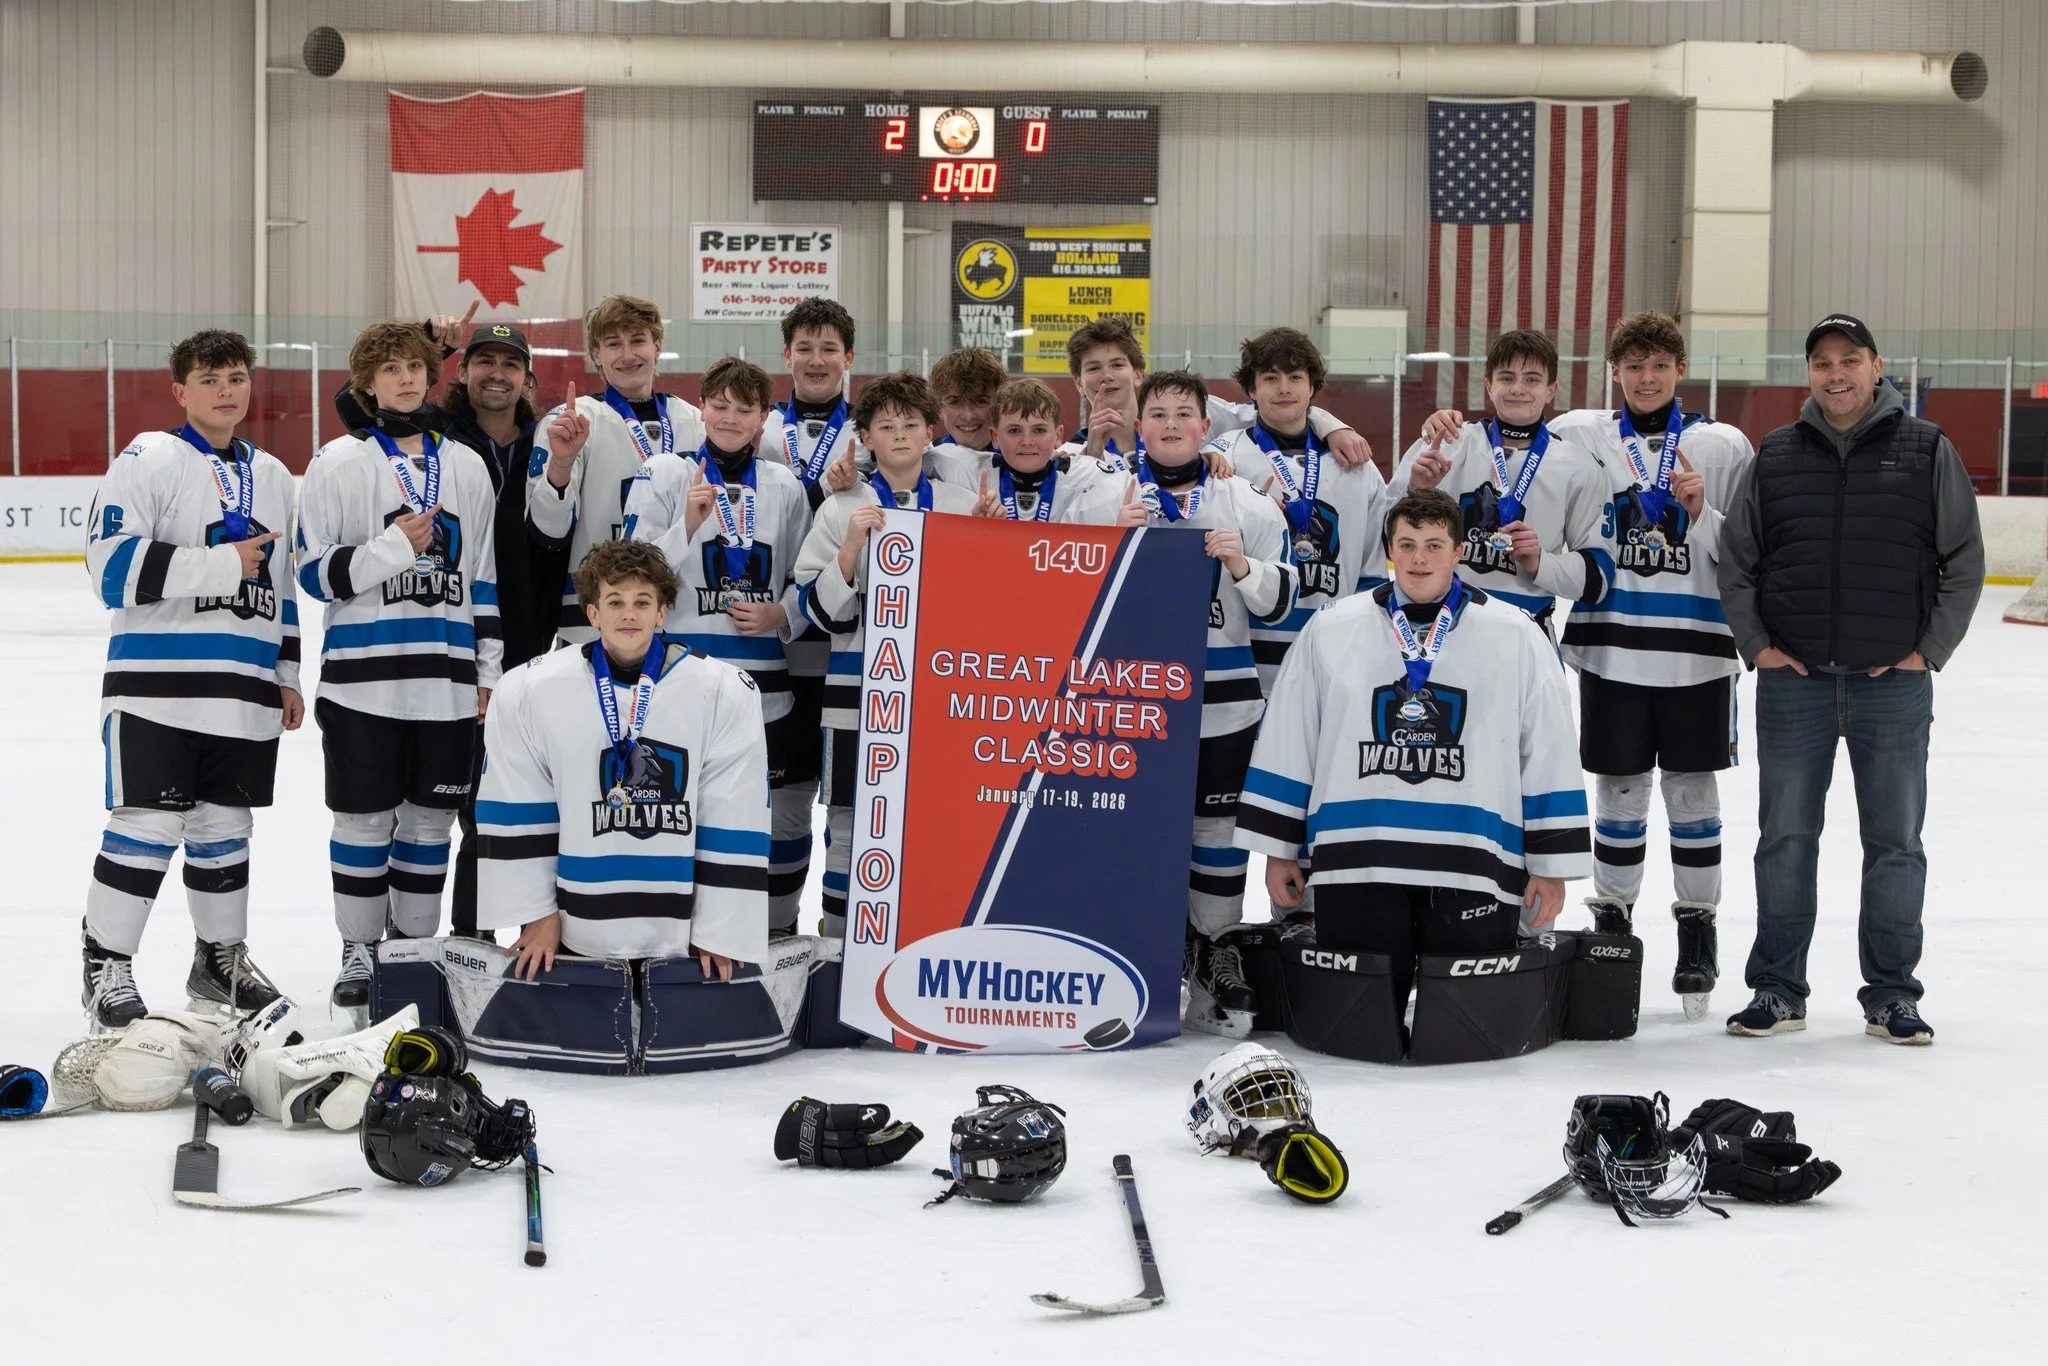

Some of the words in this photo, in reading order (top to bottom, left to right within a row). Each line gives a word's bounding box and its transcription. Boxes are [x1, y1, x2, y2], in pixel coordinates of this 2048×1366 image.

[758, 106, 794, 115] PLAYER
[804, 106, 846, 116] PENALTY
[864, 104, 909, 118] HOME
[1003, 106, 1052, 120] GUEST
[1062, 108, 1097, 118] PLAYER
[1107, 110, 1148, 120] PENALTY
[885, 120, 906, 151] 2
[1025, 121, 1046, 152] 0
[933, 162, 997, 193] 0:00
[700, 230, 832, 252] REPETE'S
[1059, 242, 1090, 252] WEST
[1092, 242, 1126, 252] SHORE
[702, 256, 762, 274] PARTY
[768, 256, 828, 274] STORE
[1056, 252, 1120, 264] HOLLAND
[760, 282, 789, 290] Liquor
[797, 282, 830, 291] Lottery
[1068, 286, 1112, 297] LUNCH
[722, 294, 802, 304] 616-399-005
[959, 304, 1014, 316] BUFFALO
[1068, 298, 1112, 306] MADNESS
[722, 308, 752, 316] Corner
[1030, 314, 1087, 324] BONELESS
[958, 316, 1014, 334] WILD
[958, 332, 1014, 348] WINGS
[632, 424, 654, 458] MYHOCK
[661, 416, 672, 454] MPION
[1502, 428, 1530, 439] CCM
[807, 426, 838, 480] CHAMPION
[1658, 432, 1678, 490] CHAMPION
[1304, 448, 1318, 500] CHAMPION
[1514, 452, 1540, 502] CHAMPION
[238, 460, 252, 518] CHAMPION
[1468, 527, 1493, 542] GARD
[1029, 539, 1107, 575] 14U
[1461, 540, 1516, 572] OLVE
[386, 570, 460, 602] WOLVS
[720, 576, 752, 592] GDEN
[1304, 563, 1336, 594] VES
[700, 590, 774, 612] WOVES
[930, 649, 1054, 684] GREAT
[1067, 658, 1190, 695] LAKES
[598, 676, 620, 742] CHAMPION
[634, 684, 651, 732] MYHOCKEY
[949, 692, 1166, 735] MIDWINTER
[854, 532, 914, 944] CHAMPION
[1391, 728, 1436, 746] GARDEN
[973, 734, 1134, 773] CLASSIC
[1362, 744, 1461, 778] WOLVES
[770, 768, 786, 779] CM
[432, 784, 472, 794] BAUE
[976, 784, 1036, 810] January
[1042, 788, 1083, 810] 17-19,
[1092, 791, 1126, 810] 2026
[1204, 794, 1242, 804] CC
[593, 804, 690, 832] WOLVES
[1461, 902, 1499, 920] CCM
[445, 950, 488, 972] BAUER
[774, 950, 812, 972] BAUER
[1301, 949, 1358, 972] CCM
[1449, 954, 1521, 977] CCM
[918, 958, 1106, 1006] MYHOCKEY
[944, 1006, 1077, 1030] TOURNAMENTS
[798, 1104, 820, 1166] UER
